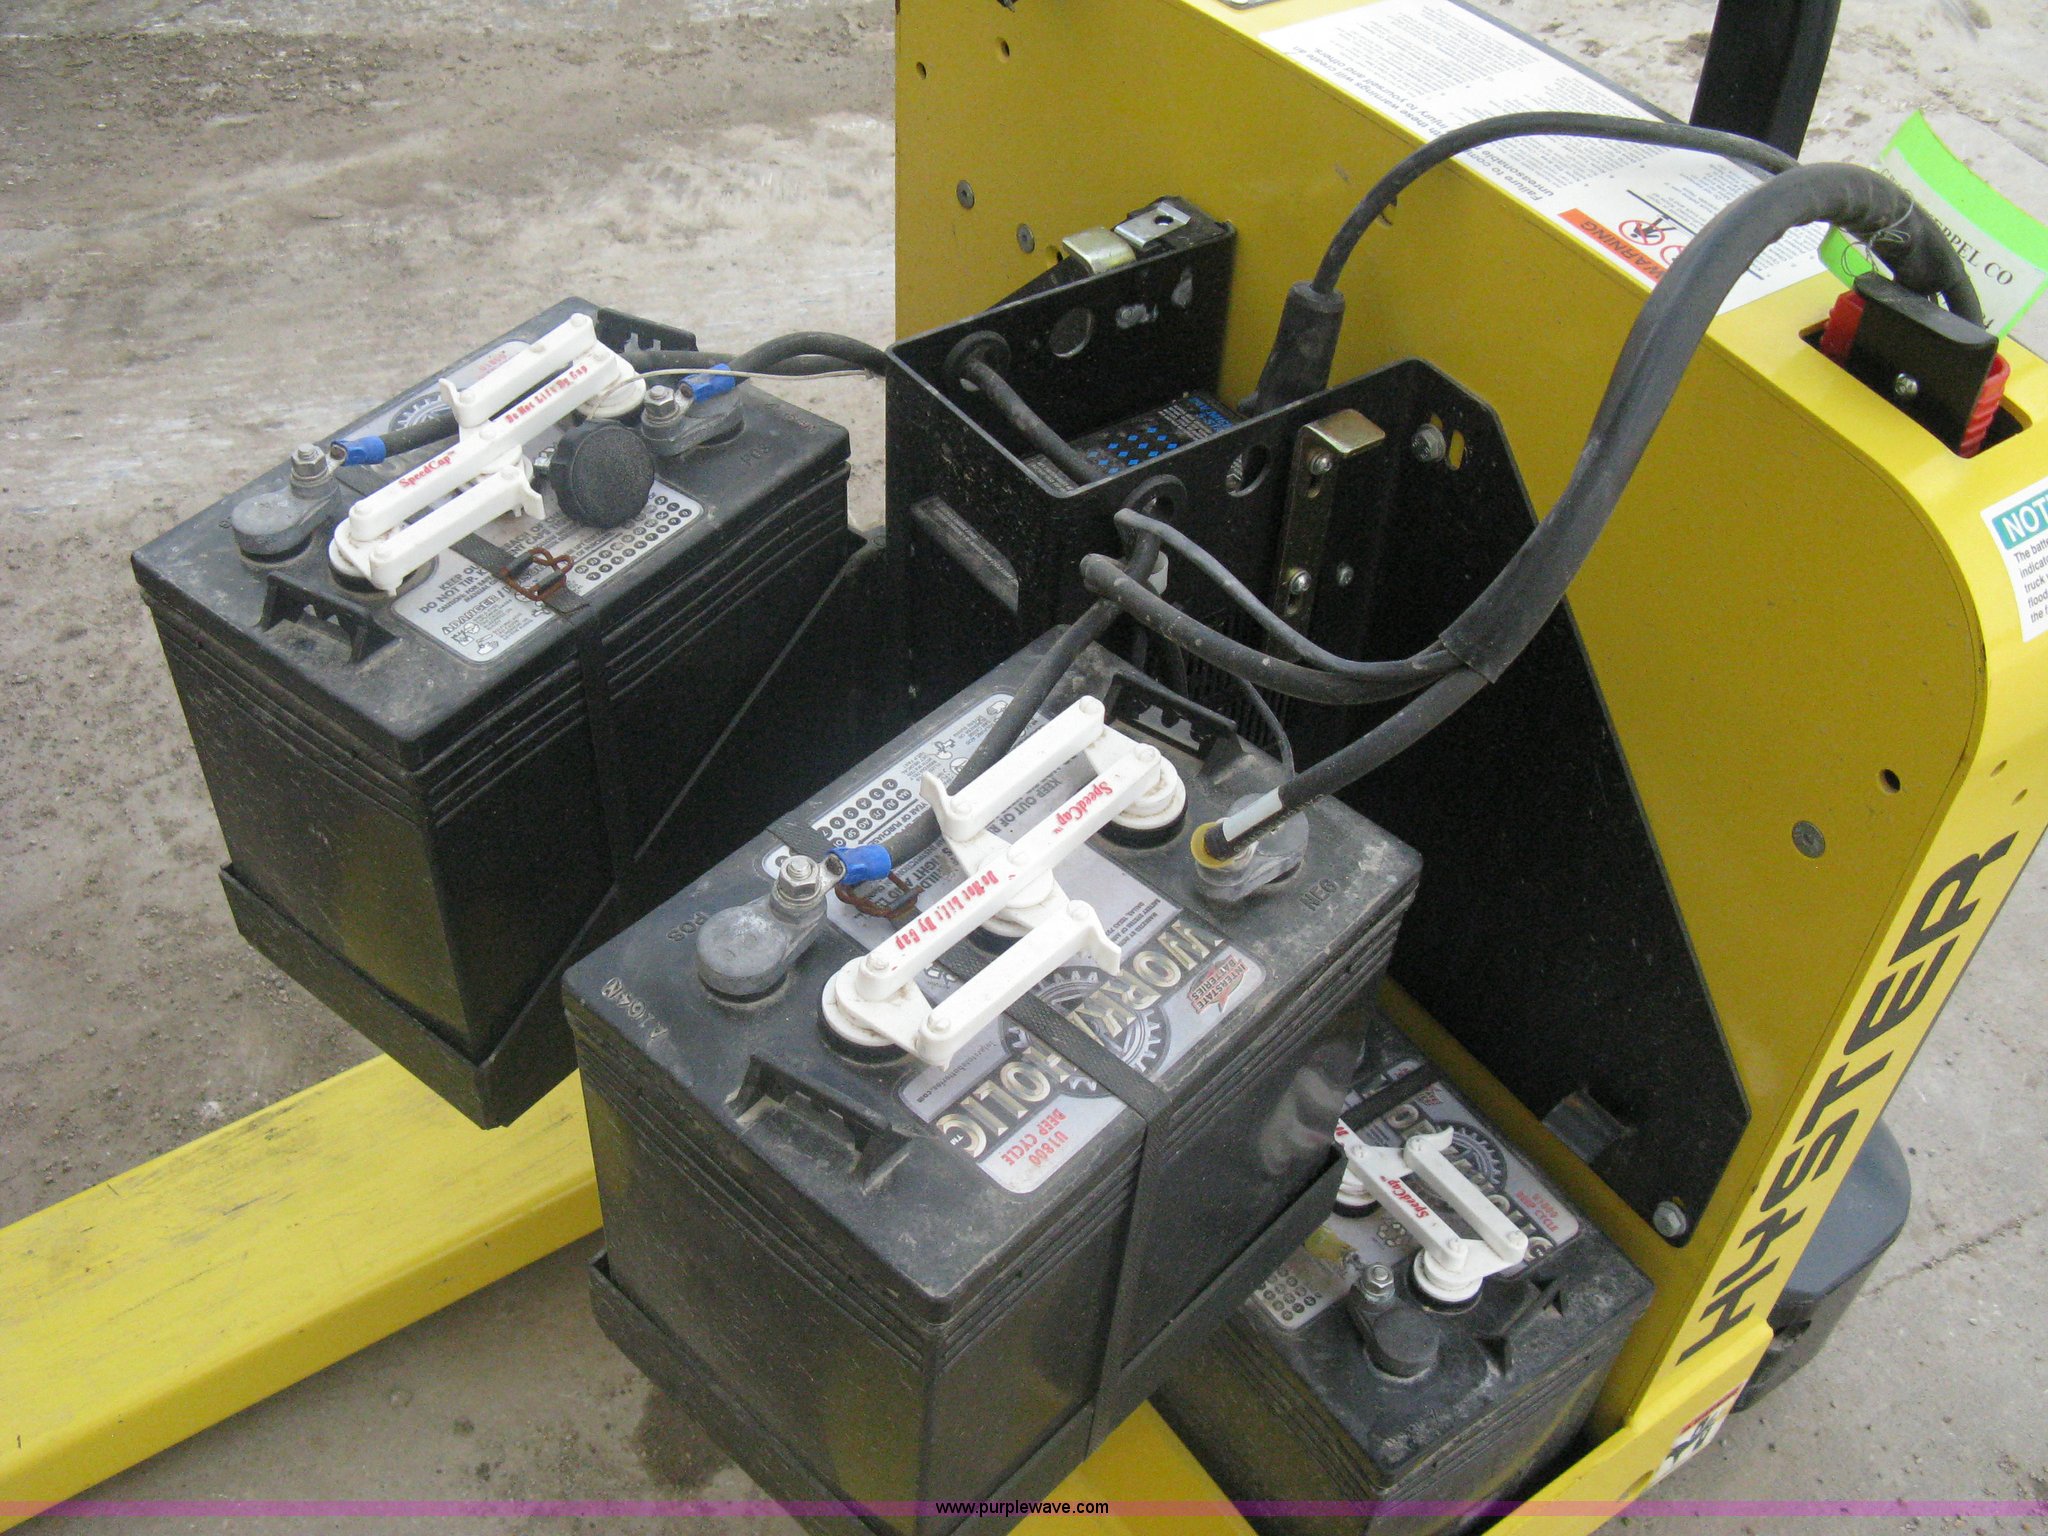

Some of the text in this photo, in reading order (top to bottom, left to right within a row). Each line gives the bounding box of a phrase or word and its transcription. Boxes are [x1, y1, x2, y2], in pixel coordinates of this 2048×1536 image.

[1351, 81, 1403, 110] warnings
[1396, 109, 1430, 127] these
[1477, 150, 1555, 197] unreasonable
[1500, 175, 1544, 201] Failure
[461, 563, 479, 575] OU
[2014, 548, 2031, 564] The
[2025, 576, 2046, 594] truck
[1011, 795, 1038, 815] OUT
[1051, 779, 1115, 828] SpeedCap
[996, 811, 1016, 827] OF
[1676, 831, 2019, 1366] HYSTER
[998, 1107, 1068, 1166] DEEP CYCLE
[1023, 1129, 1070, 1166] U1800
